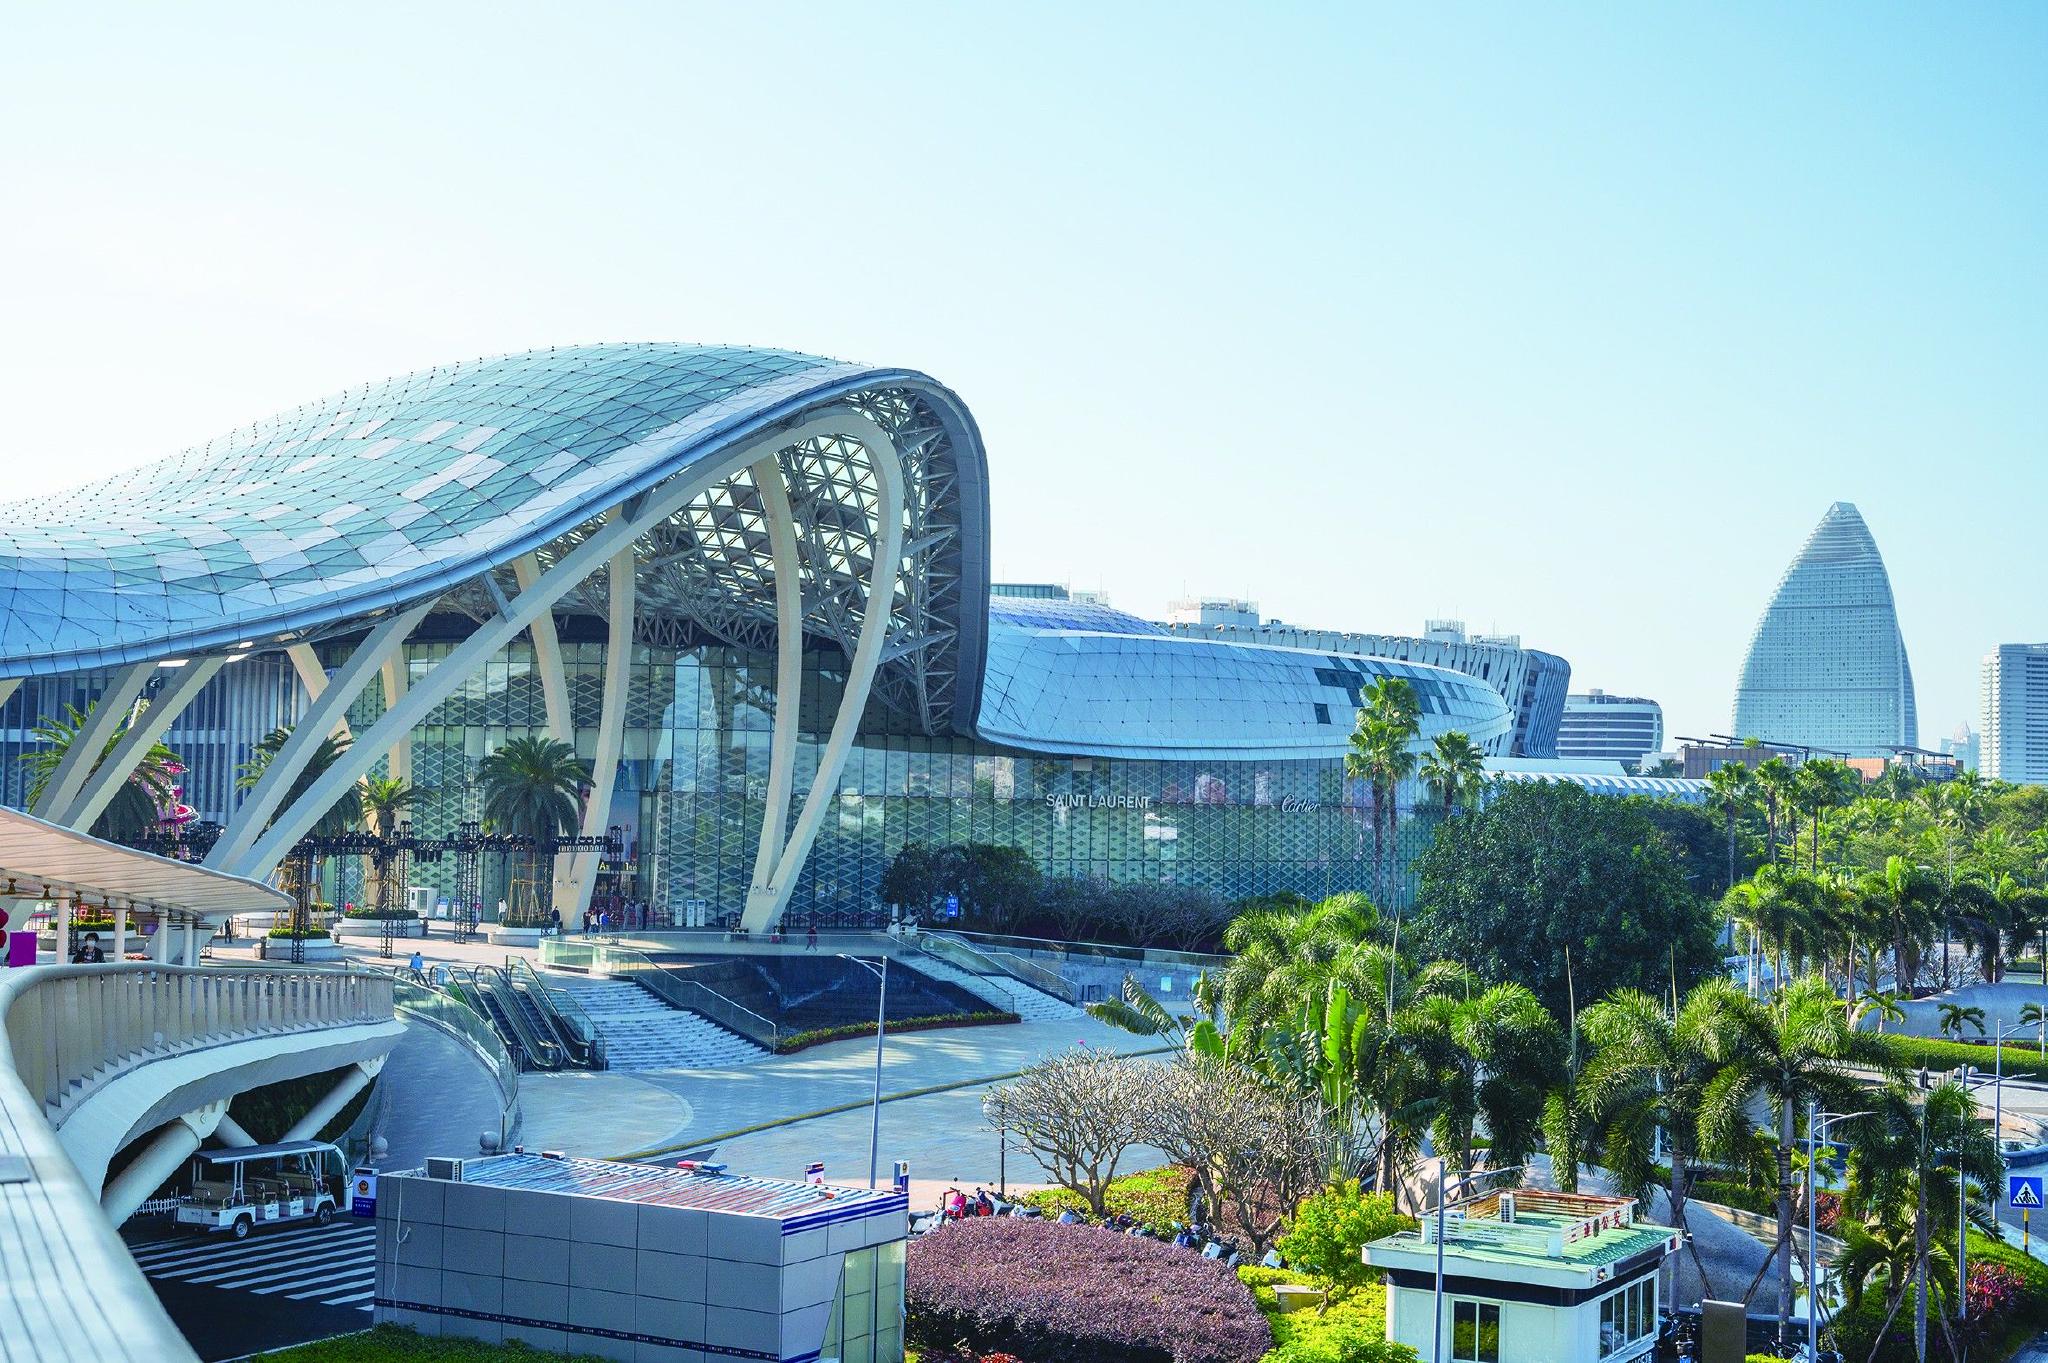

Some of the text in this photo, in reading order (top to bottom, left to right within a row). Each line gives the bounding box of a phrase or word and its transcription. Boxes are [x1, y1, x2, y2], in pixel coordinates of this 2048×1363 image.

[1046, 793, 1151, 808] SAINT LAURENT
[1282, 793, 1320, 813] Cartier
